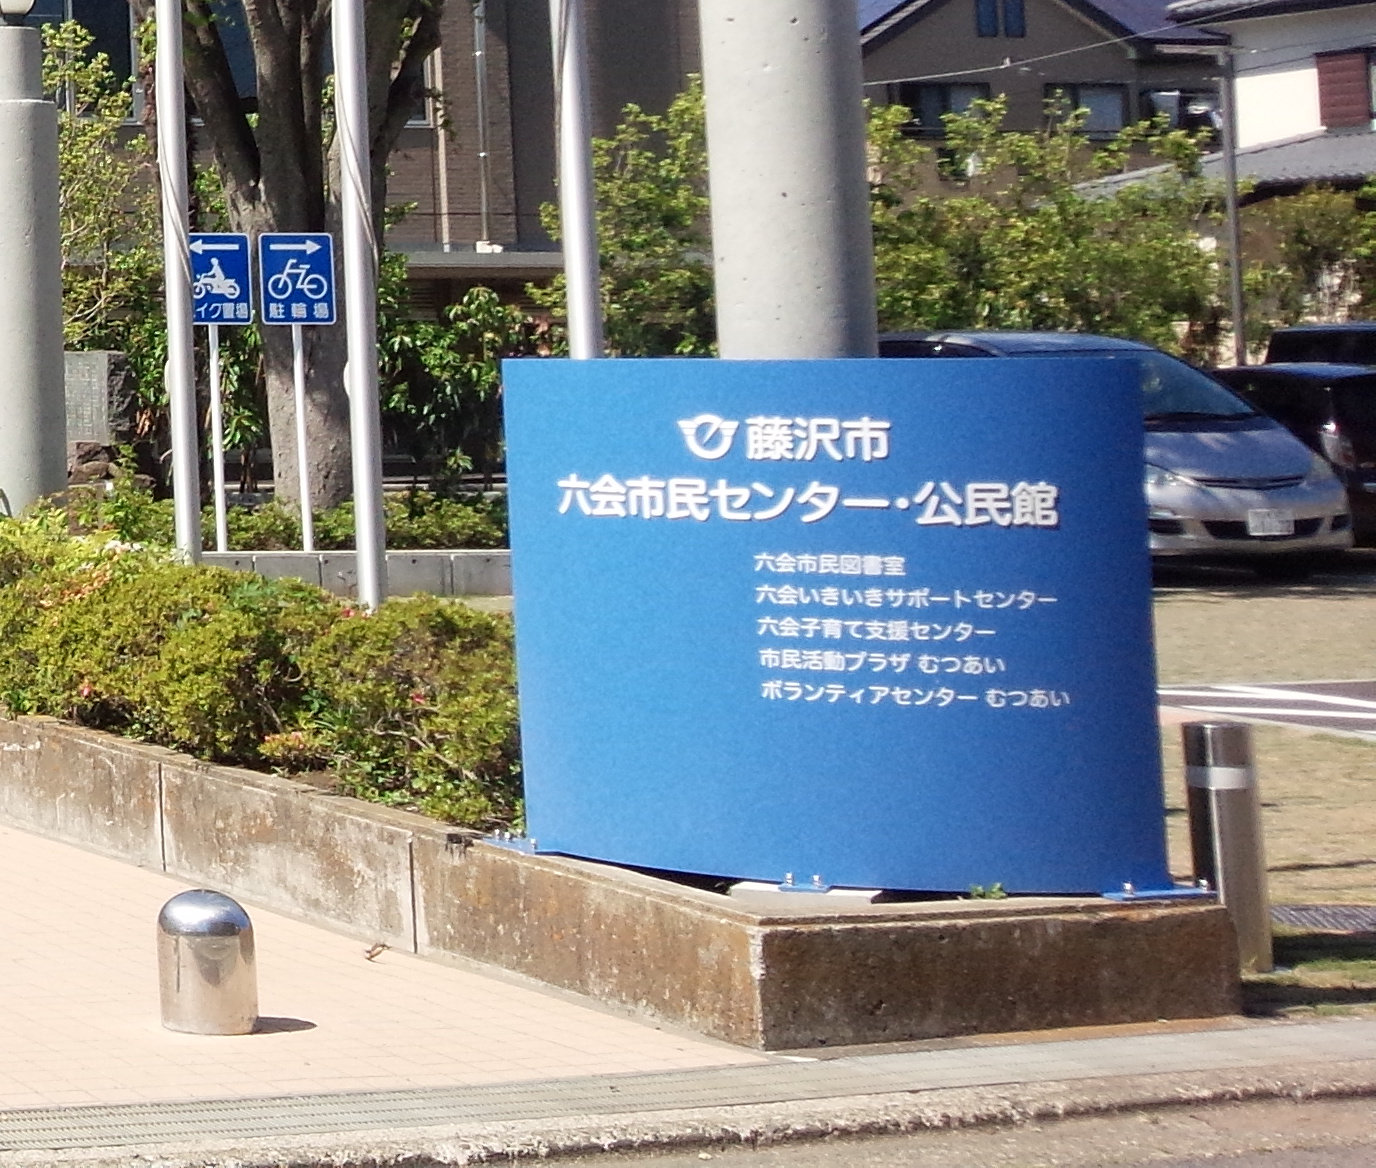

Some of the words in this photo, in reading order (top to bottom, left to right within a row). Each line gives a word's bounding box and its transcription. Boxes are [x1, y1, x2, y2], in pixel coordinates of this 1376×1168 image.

[194, 302, 248, 319] イク置場
[269, 302, 329, 319] 駐輪場
[744, 415, 891, 461] 藤沢市
[556, 473, 1060, 527] 六会市民センター・公民館
[753, 552, 906, 576] 六会市民図書室
[755, 584, 1058, 609] 六会いきいきサポートセンター
[757, 616, 996, 641] 六会子育て支援センター
[759, 648, 911, 673] 市民活動プラザ
[917, 654, 1006, 674] むつあい
[761, 680, 979, 707] ボランティアセンター
[985, 688, 1071, 708] むつあい
